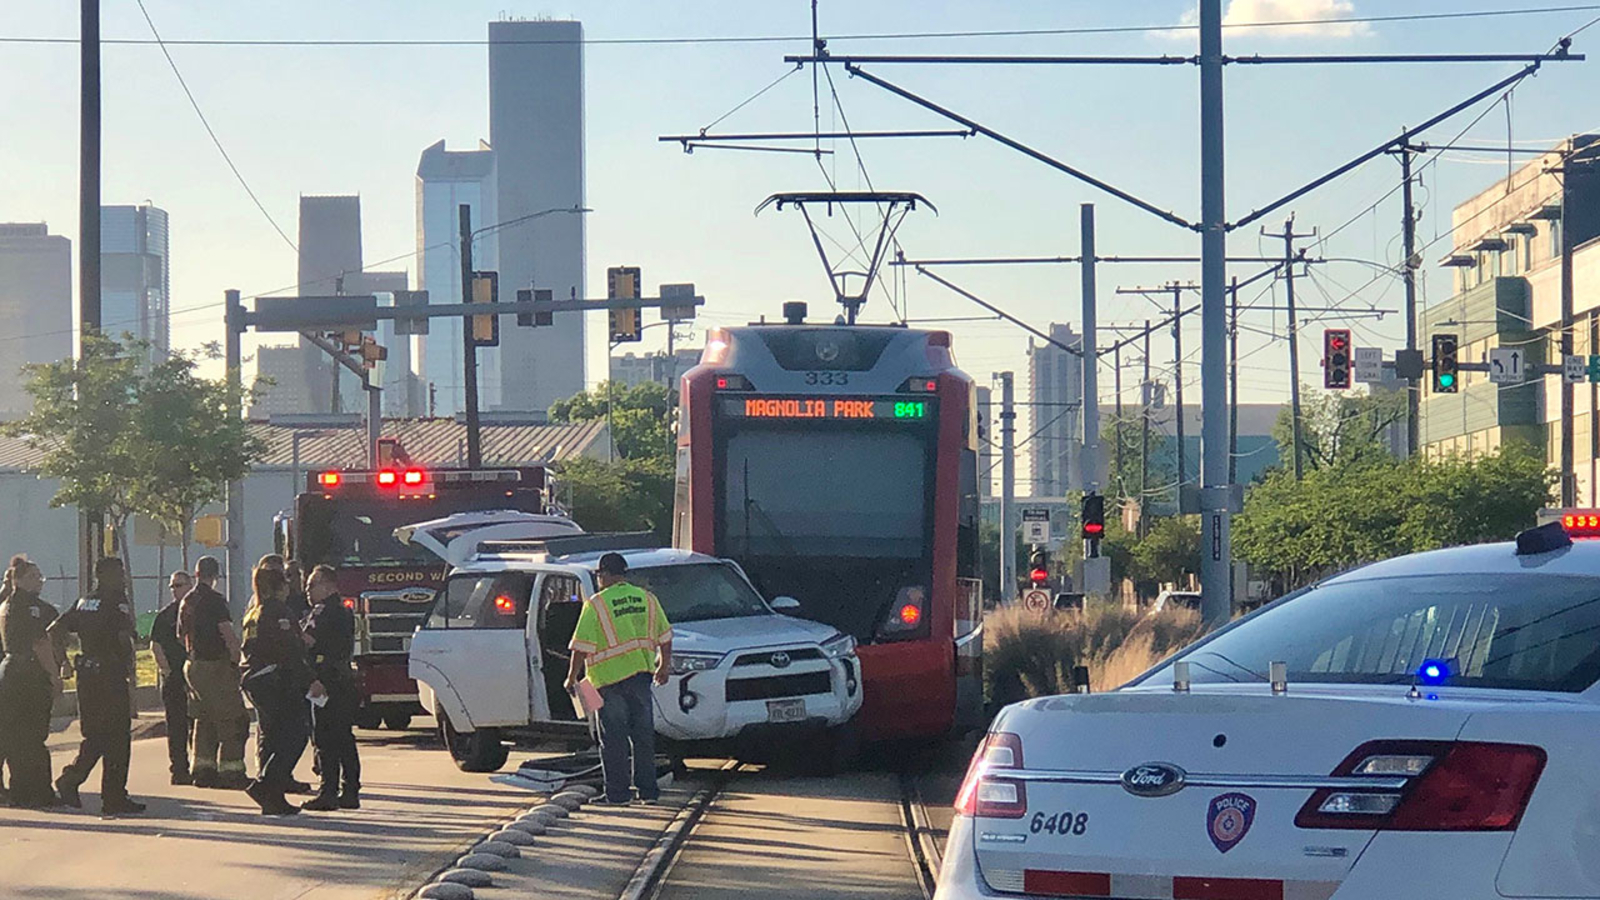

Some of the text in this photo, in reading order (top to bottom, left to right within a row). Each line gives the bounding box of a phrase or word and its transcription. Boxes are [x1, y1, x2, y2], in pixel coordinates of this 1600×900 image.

[1361, 351, 1377, 359] LEFT
[805, 372, 848, 386] 333
[745, 399, 874, 418] MAGNOLIA PARK
[894, 402, 923, 418] 841
[368, 572, 424, 583] SECOND
[1131, 767, 1166, 785] Ford
[1216, 798, 1250, 811] POLICE
[1030, 812, 1088, 836] 6408
